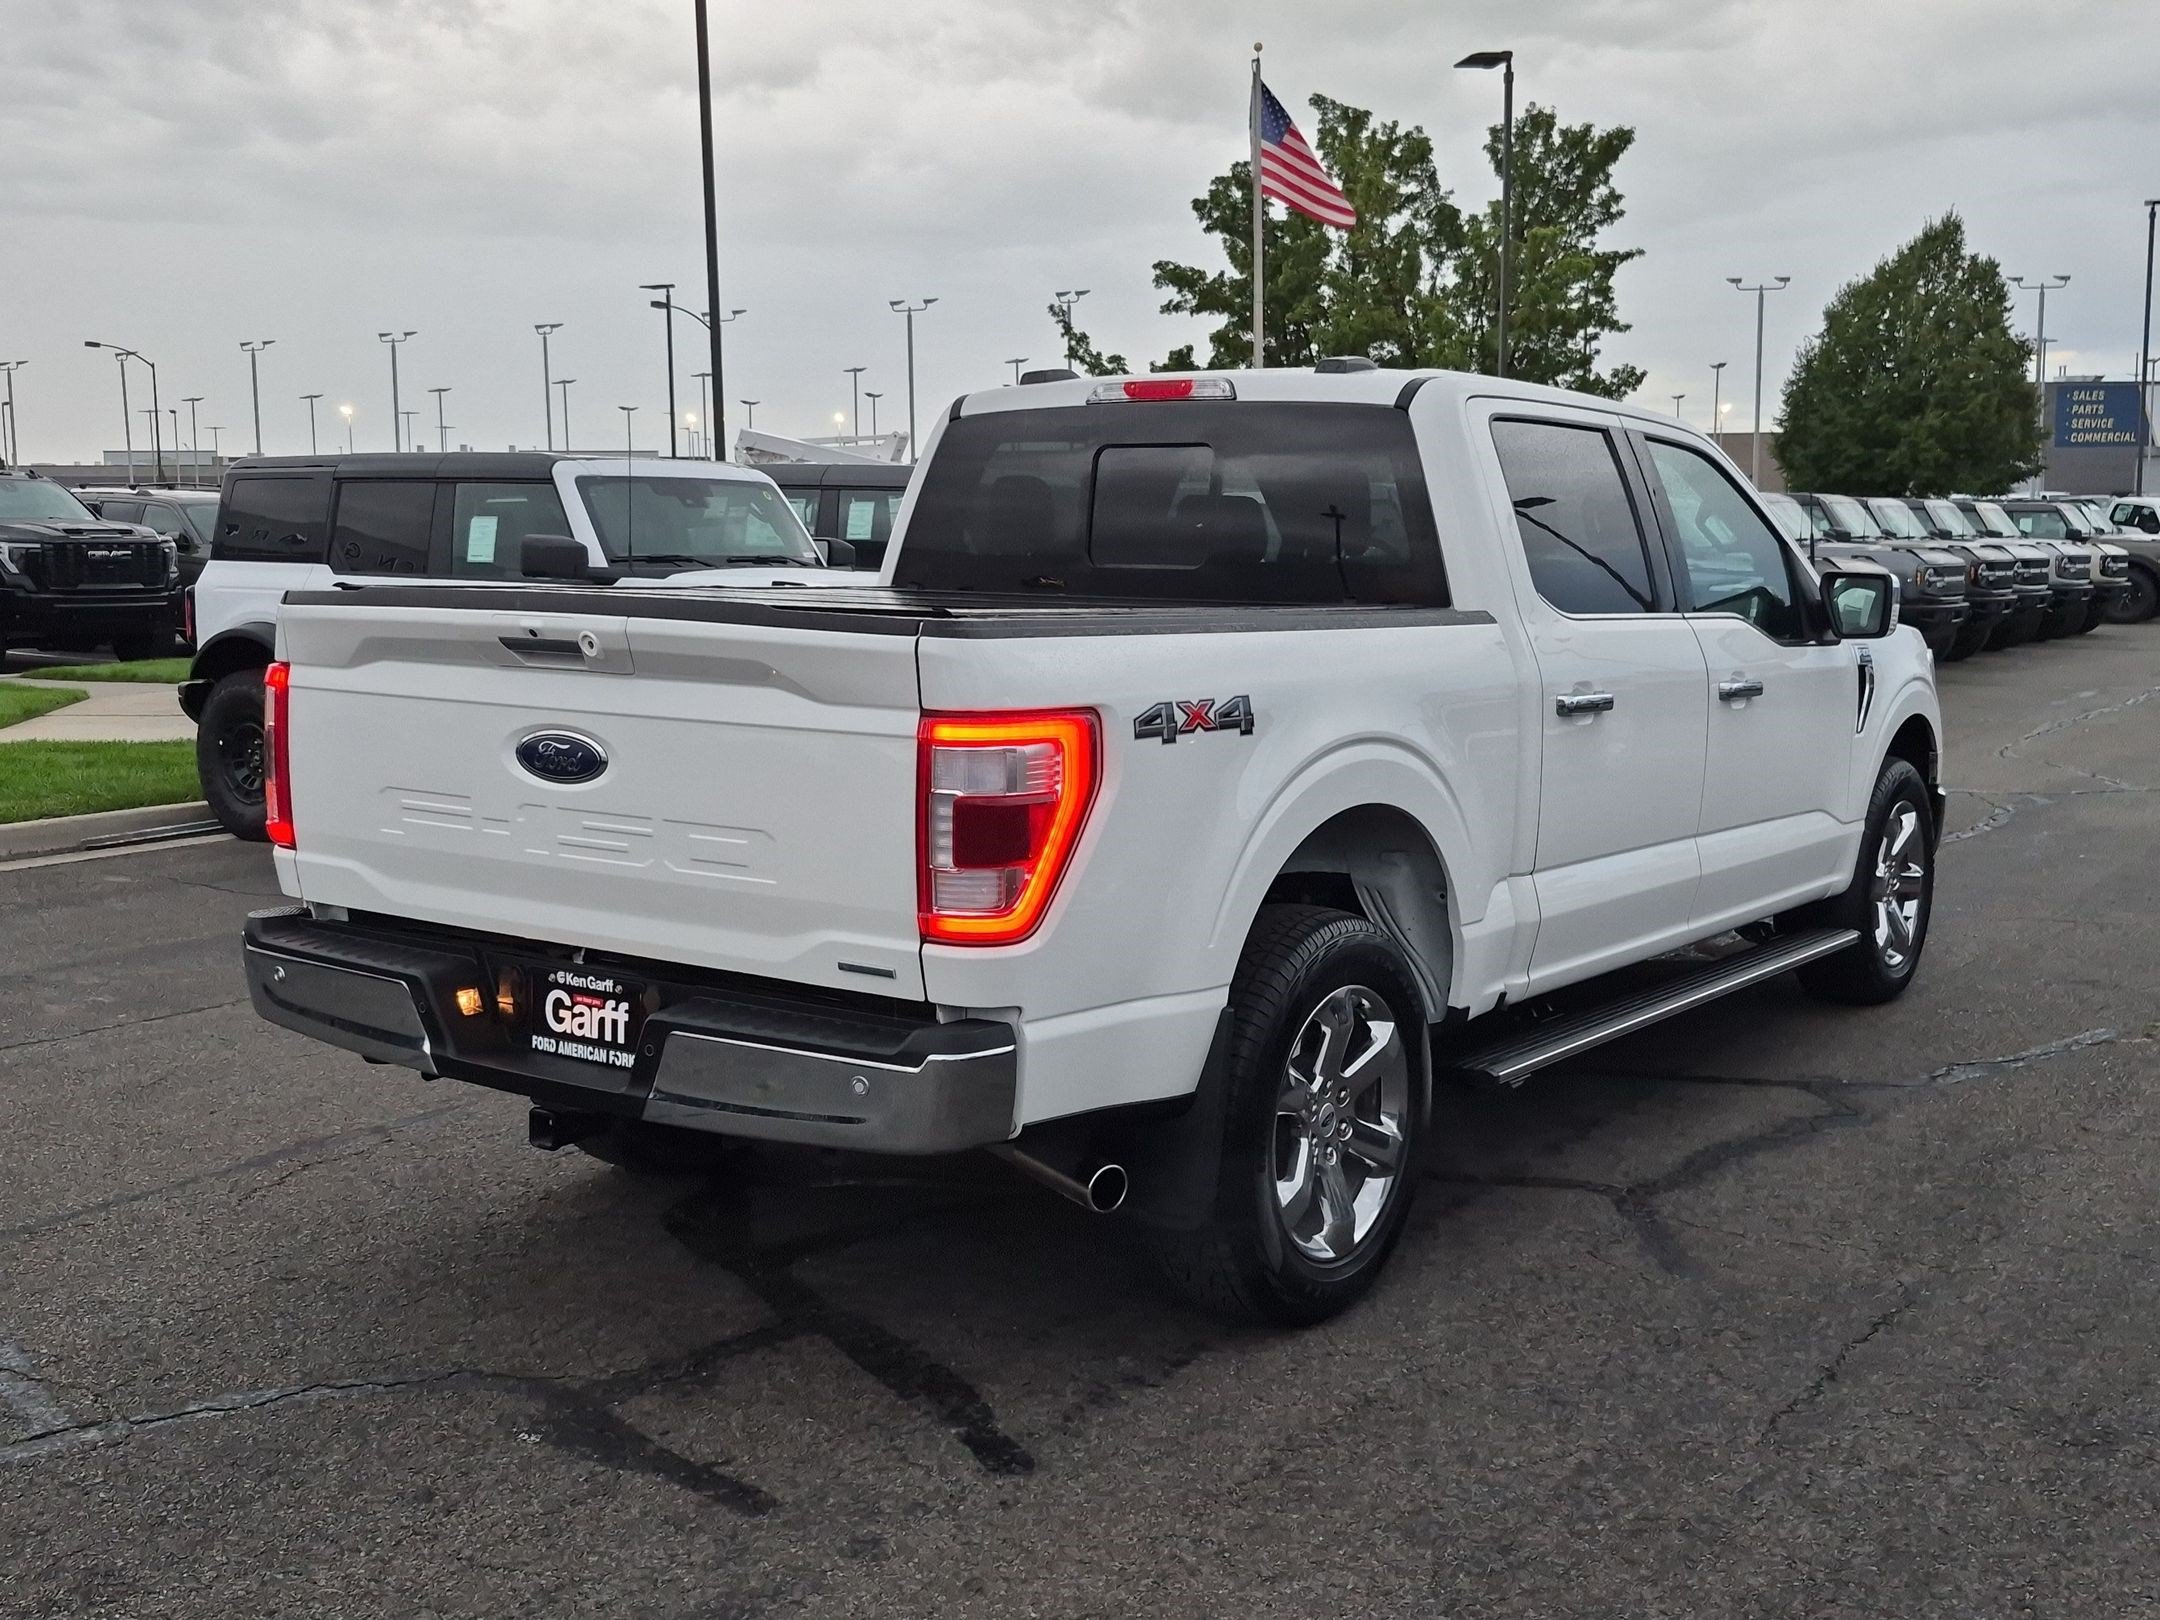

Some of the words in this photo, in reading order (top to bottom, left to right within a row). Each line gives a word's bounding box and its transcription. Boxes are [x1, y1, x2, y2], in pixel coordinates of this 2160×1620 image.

[2072, 390, 2105, 400] SALES
[2071, 404, 2104, 415] PARTS
[2071, 418, 2115, 429] SERVICE
[2070, 432, 2136, 443] COMMERCIAL
[566, 972, 587, 989] Ken
[587, 976, 614, 993] Garff
[545, 989, 630, 1044] Garff
[532, 1034, 557, 1053] FORD
[558, 1040, 607, 1064] AMERICAN
[608, 1050, 636, 1069] FORK
